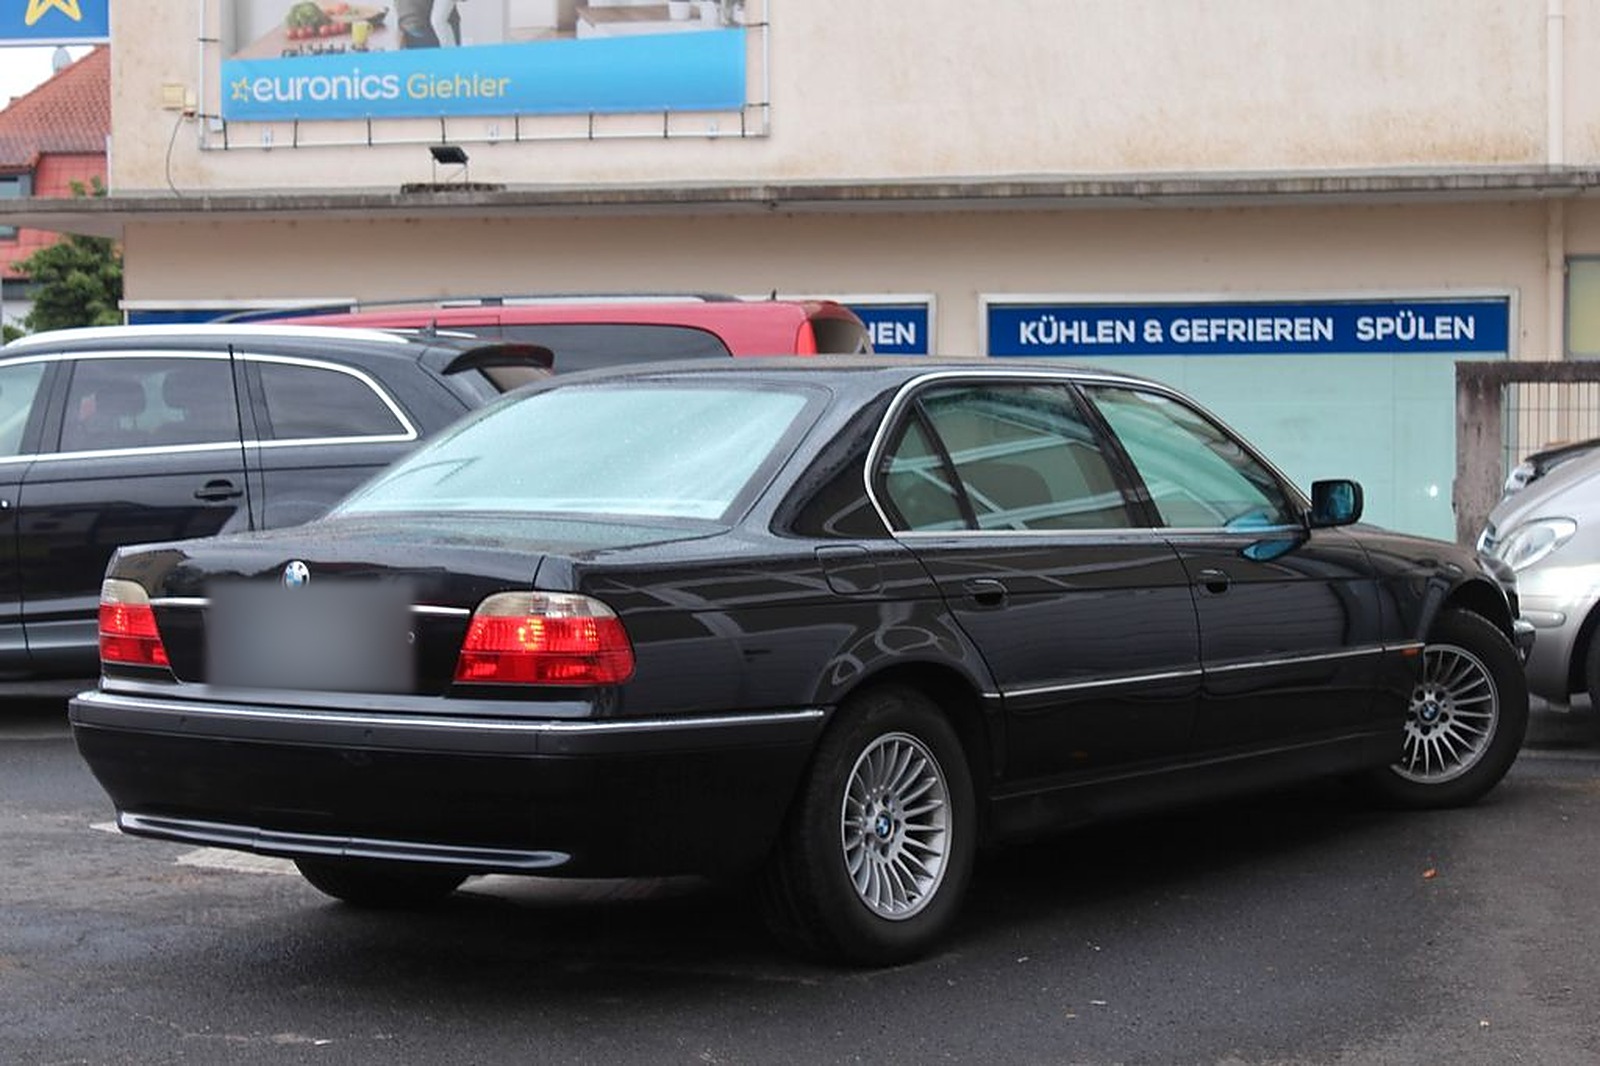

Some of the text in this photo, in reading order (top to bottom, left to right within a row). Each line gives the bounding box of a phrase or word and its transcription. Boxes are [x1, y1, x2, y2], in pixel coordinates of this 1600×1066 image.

[253, 68, 511, 101] euronics Giehler
[1019, 310, 1475, 345] KÜHLEN & GEFRIEREN SPÜLEN
